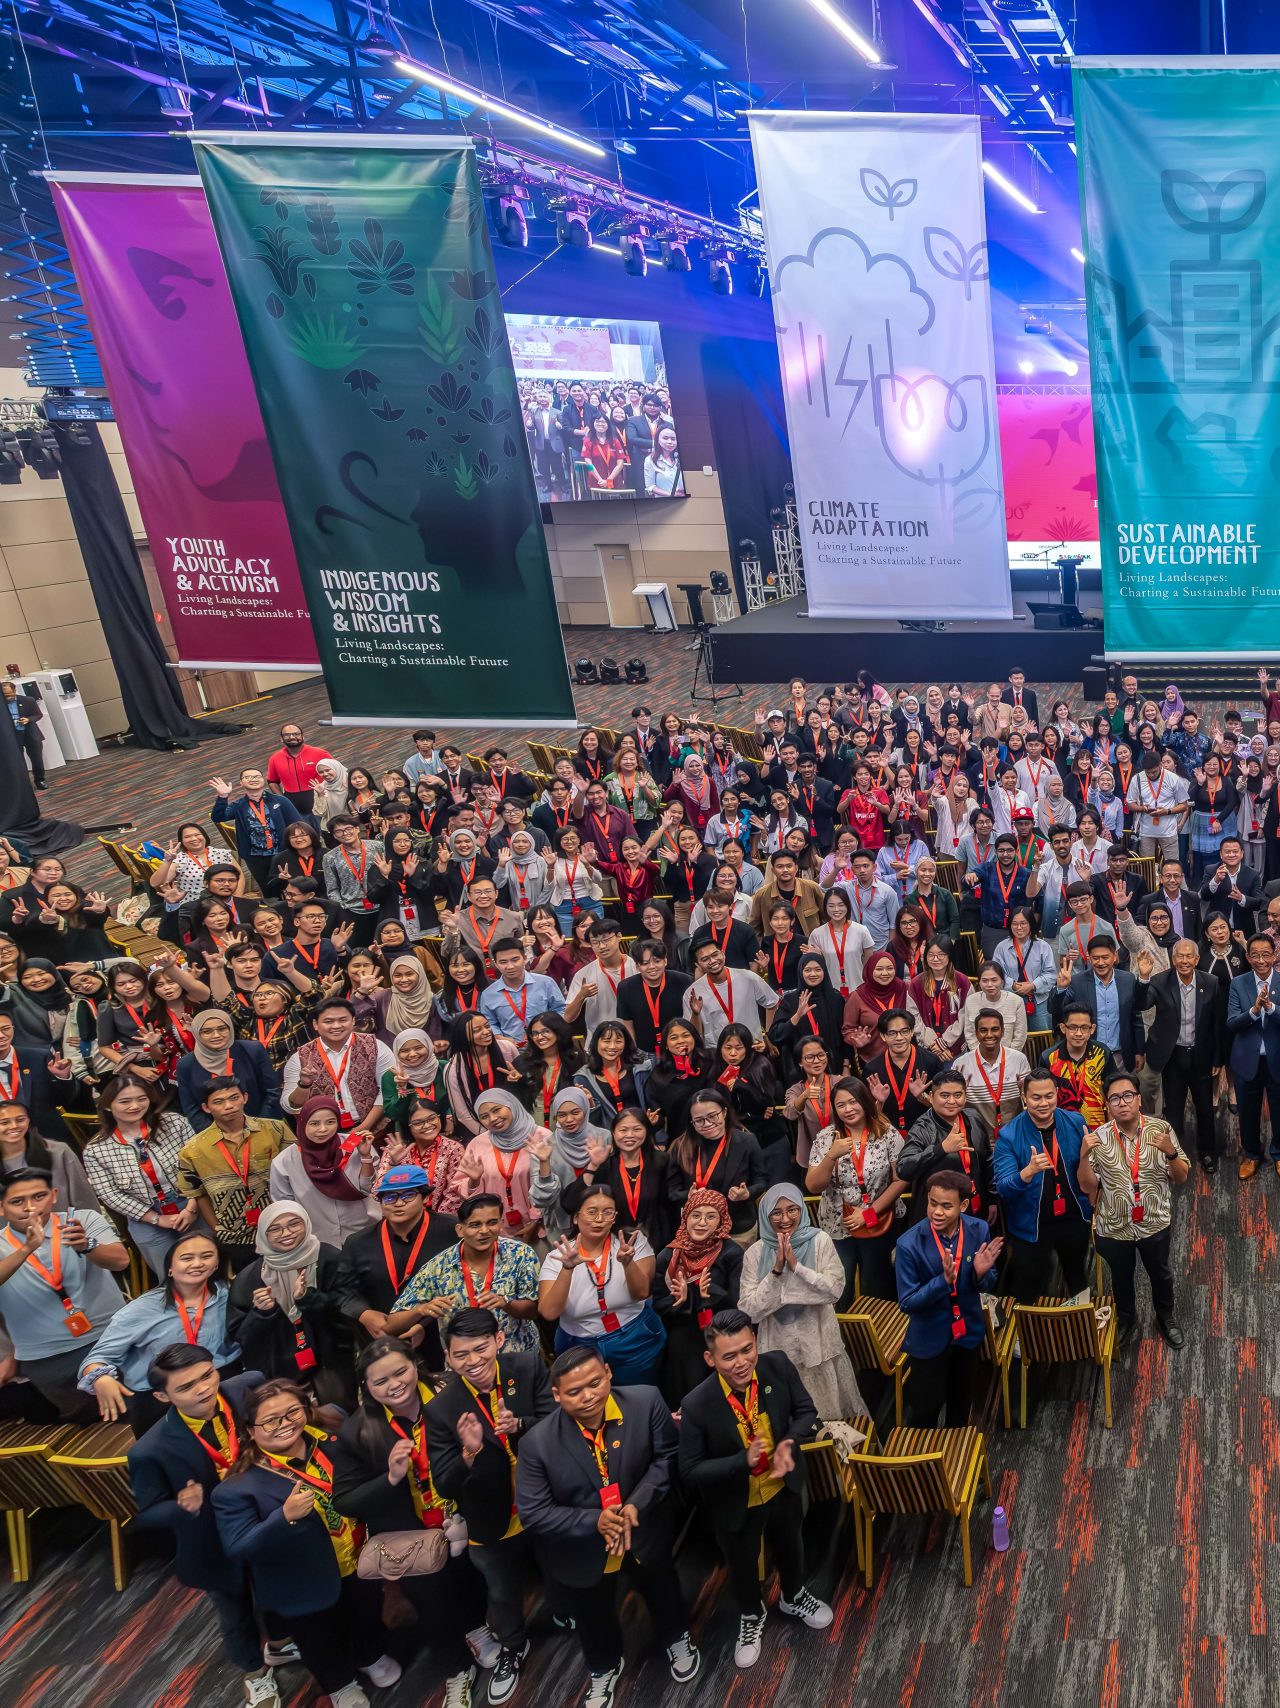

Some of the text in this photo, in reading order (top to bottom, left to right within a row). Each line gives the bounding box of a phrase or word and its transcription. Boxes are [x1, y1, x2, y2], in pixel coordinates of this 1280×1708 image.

[808, 500, 880, 519] CLIMATE
[812, 519, 929, 537] ADAPTATION
[1117, 523, 1257, 544] SUSTAINABLE
[165, 537, 226, 556] YOUTH
[817, 542, 909, 554] Living Landscapes:
[1118, 544, 1262, 565] DEVELOPMENT
[172, 555, 271, 575] ADVOCACY
[818, 555, 860, 566] Charting
[870, 556, 926, 565] Sustainable
[929, 556, 962, 565] Future
[176, 573, 280, 593] & ACTIVISM
[320, 569, 441, 592] INDIGENOUS
[1119, 572, 1228, 585] Living Landscapes:
[177, 594, 273, 607] Living Landscapes:
[324, 590, 410, 613] WISDOM
[1119, 587, 1169, 600] Charting
[1183, 587, 1247, 597] Sustainable
[181, 606, 227, 618] Charting
[236, 608, 293, 618] Sustainable
[332, 613, 442, 634] & INSIGHTS
[335, 637, 445, 654] Living Landscapes:
[338, 652, 389, 667] Charting
[399, 655, 467, 666] Sustainable
[470, 656, 509, 666] Future
